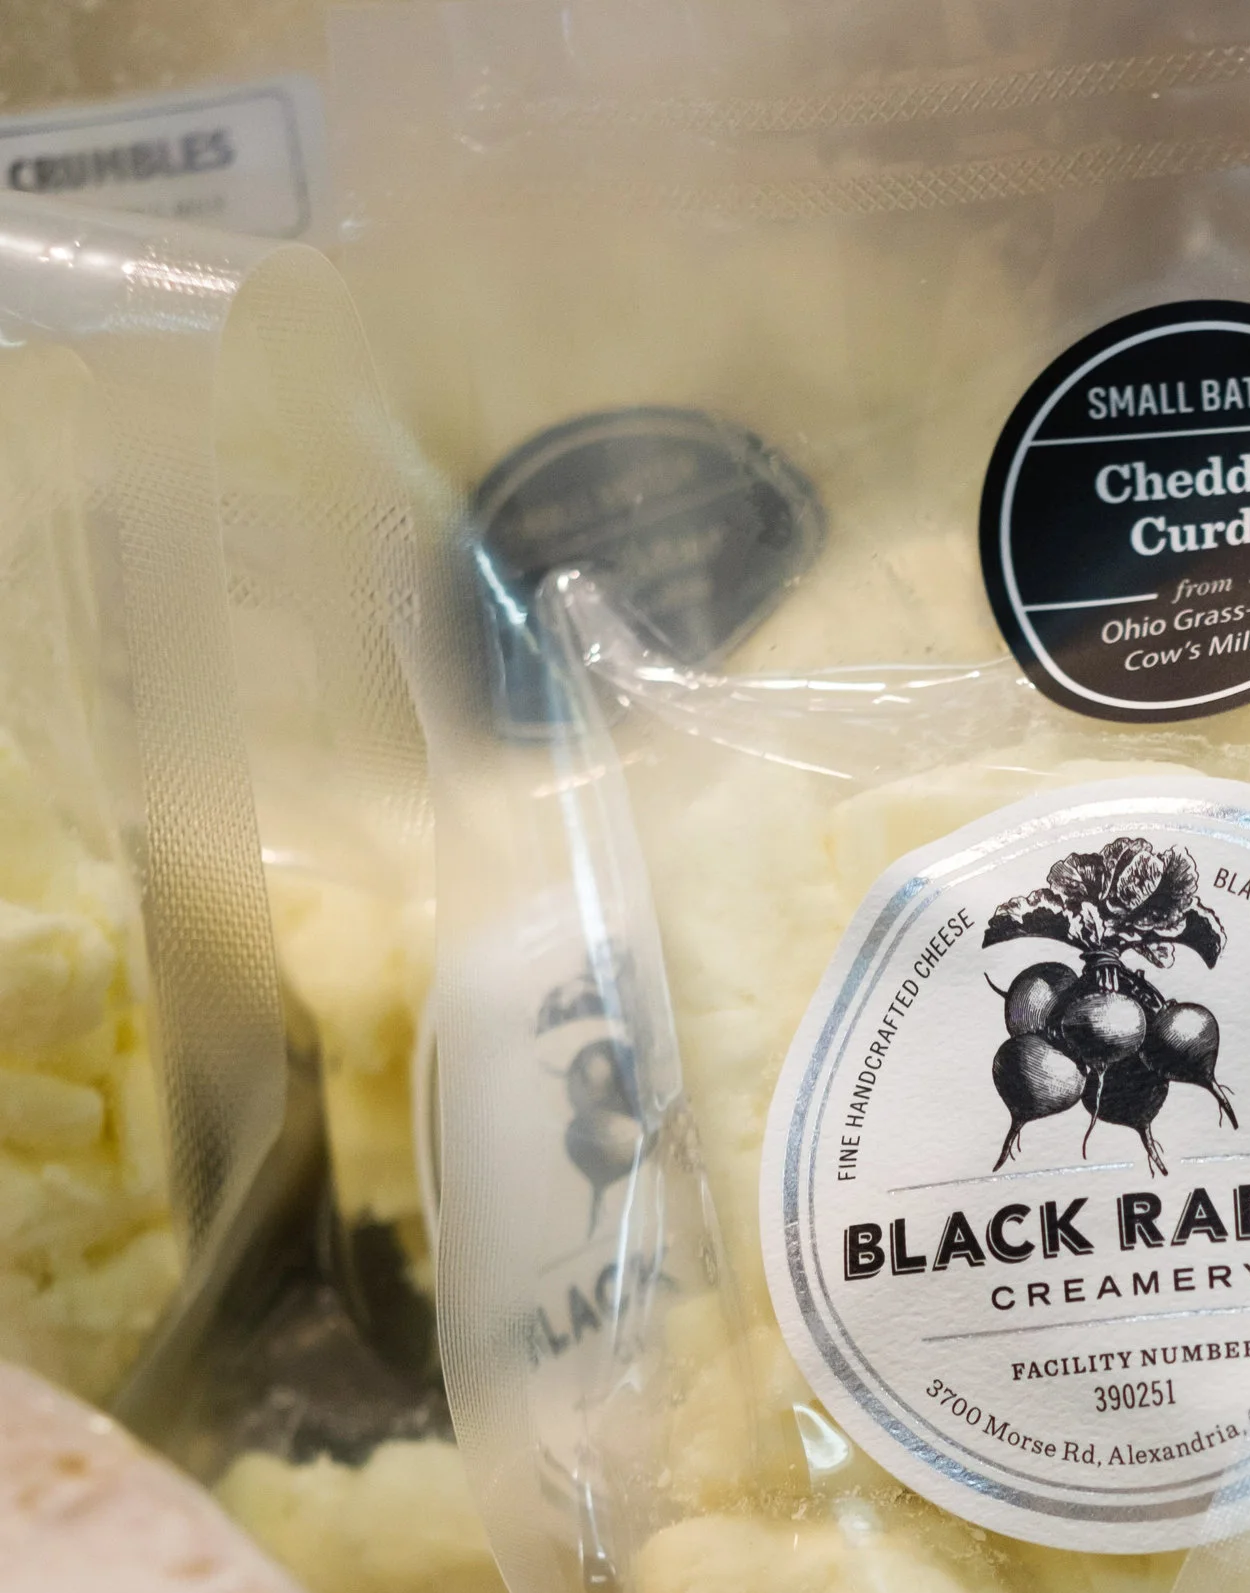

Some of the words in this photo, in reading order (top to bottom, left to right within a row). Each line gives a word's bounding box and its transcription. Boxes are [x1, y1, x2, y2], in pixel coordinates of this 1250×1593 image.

[1087, 381, 1194, 421] SMALL
[1171, 576, 1234, 604] from
[1100, 607, 1166, 645] Ohio
[1123, 641, 1201, 672] Cow's
[913, 906, 976, 979] CHEESE
[844, 978, 921, 1129] HANDCRAFTED
[837, 1134, 861, 1182] FINE
[843, 1197, 1095, 1282] BLACK
[1010, 1350, 1133, 1381] FACILITY
[1093, 1378, 1178, 1413] 390251
[925, 1378, 982, 1426] 3700
[981, 1414, 1057, 1458] Morse
[1062, 1440, 1103, 1469] Rd,
[1107, 1421, 1249, 1466] Alexandria,
